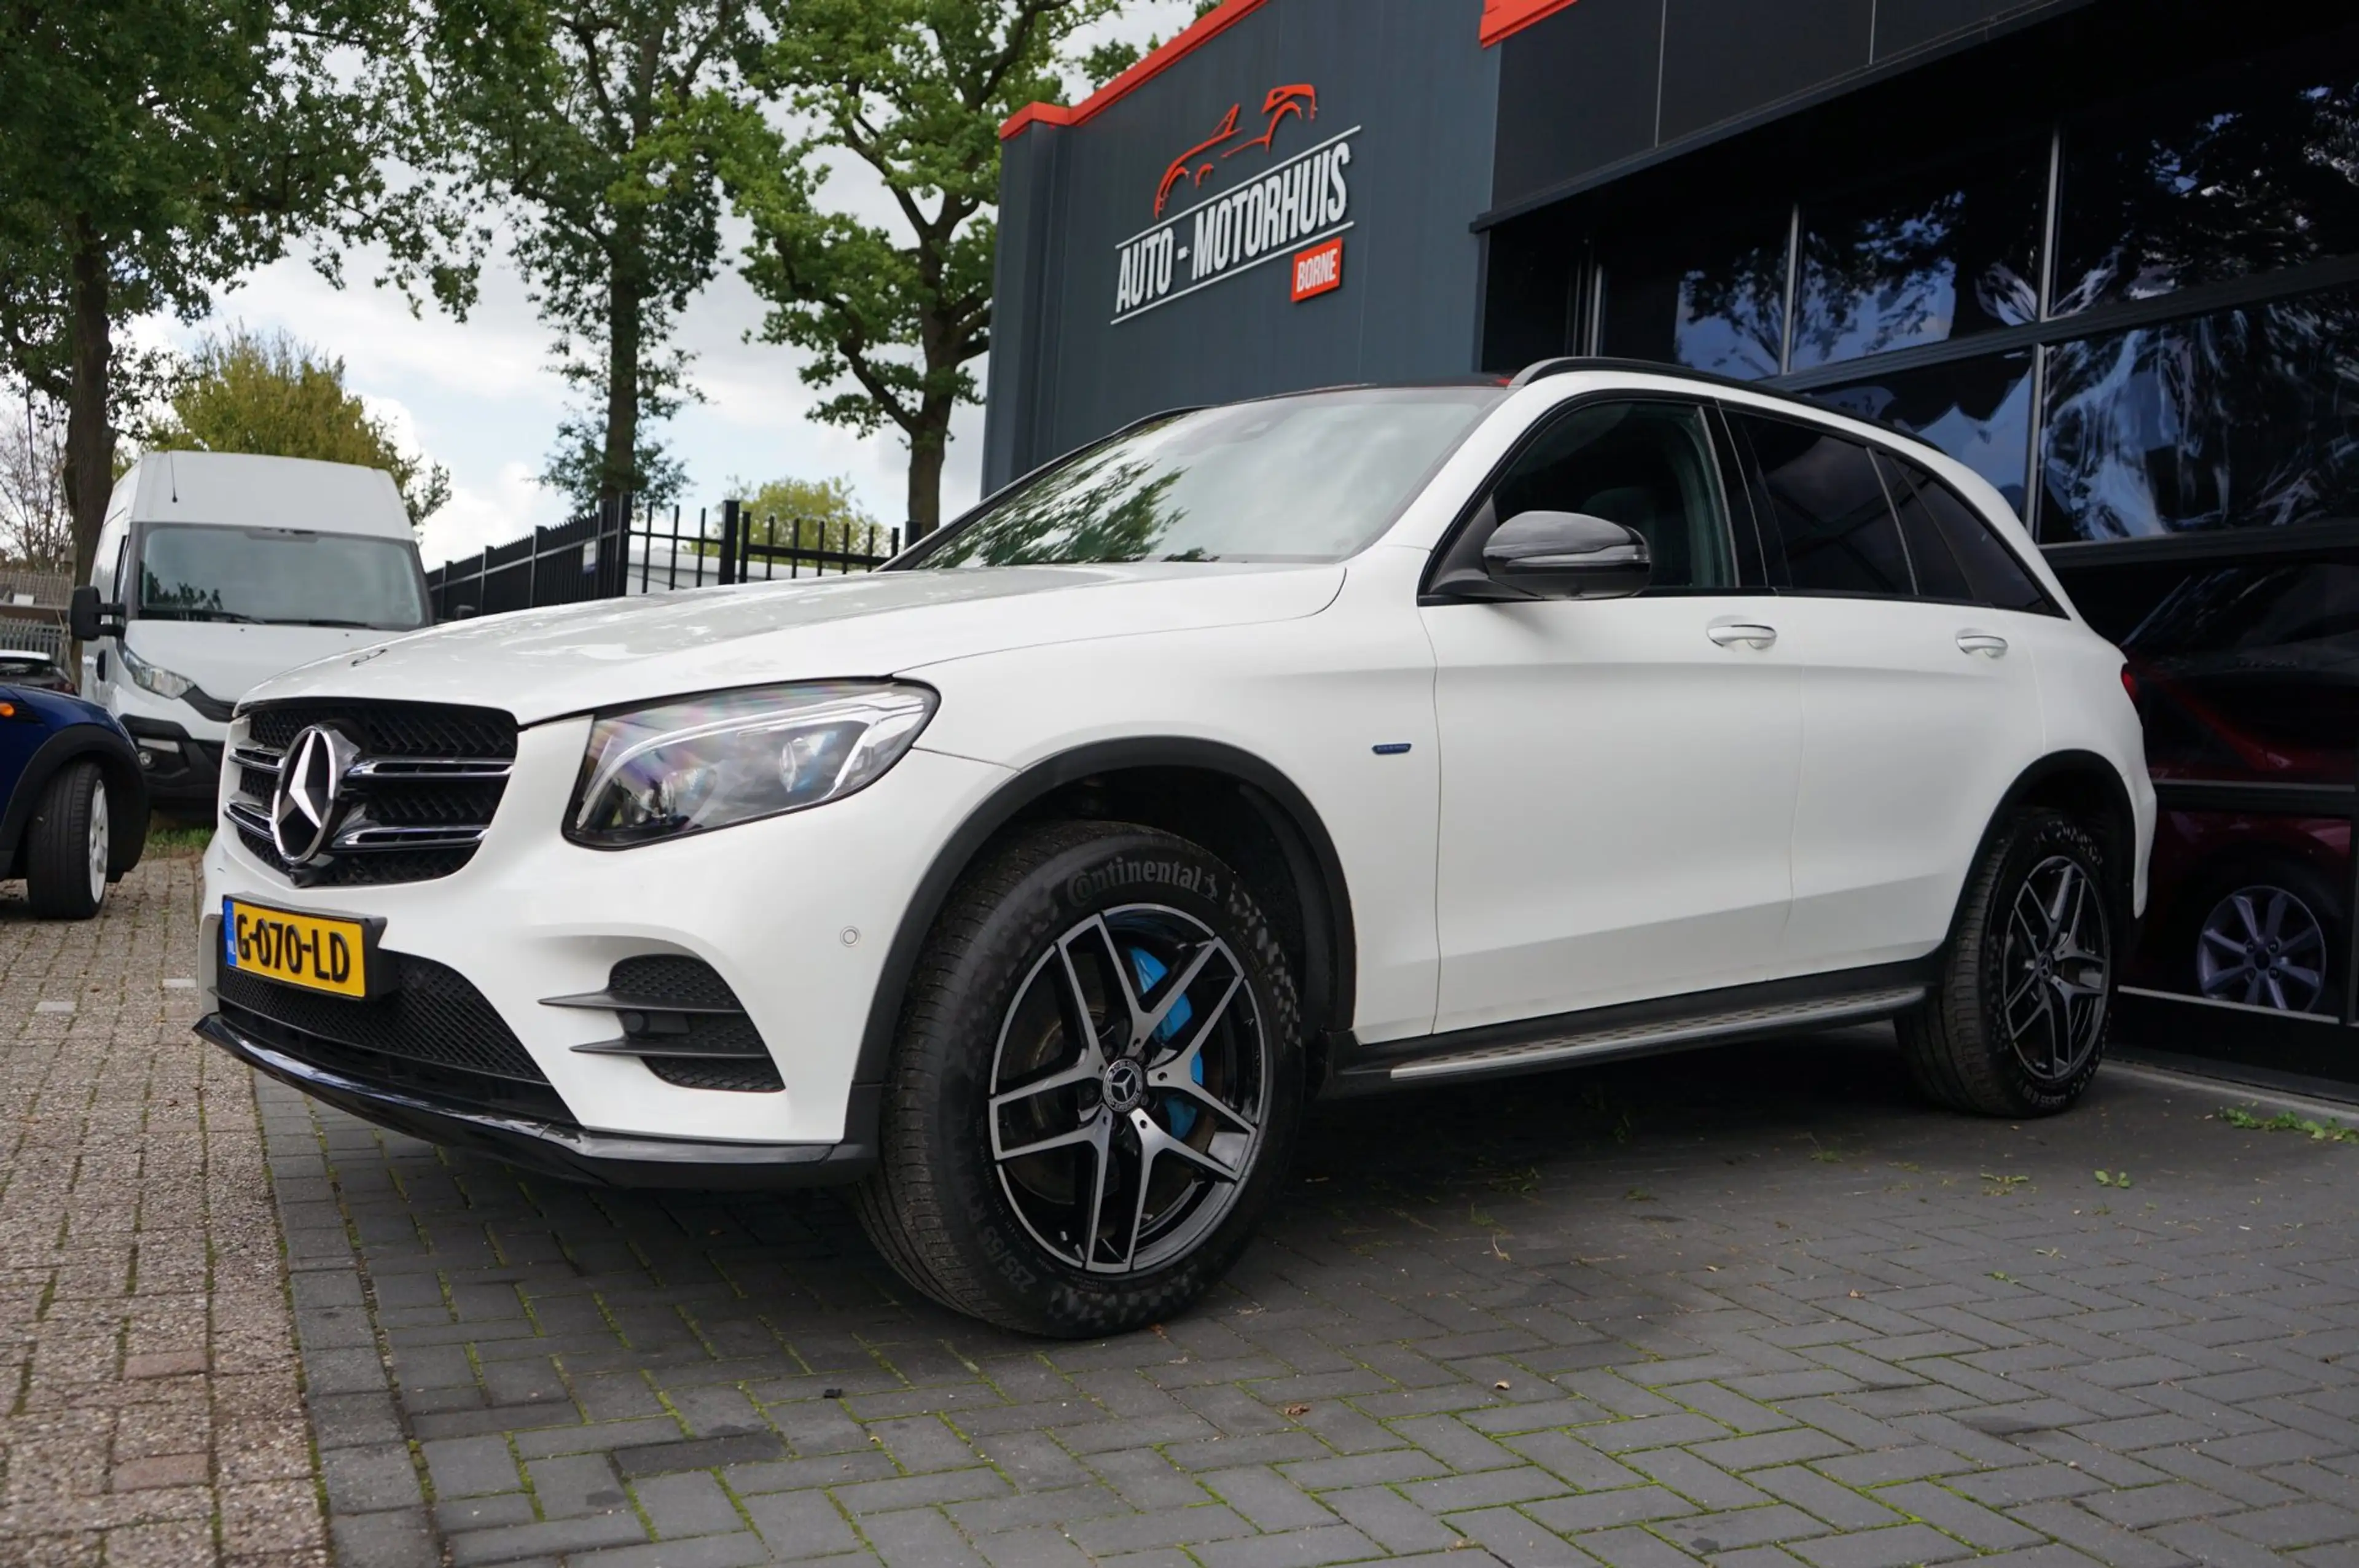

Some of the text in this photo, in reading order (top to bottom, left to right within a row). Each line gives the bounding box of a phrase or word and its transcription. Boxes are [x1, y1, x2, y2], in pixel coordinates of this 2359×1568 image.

[1116, 227, 1174, 313] AUTO
[1191, 142, 1350, 281] MOTORHUIS
[1296, 248, 1338, 293] BORNE
[1066, 856, 1202, 907] Continental
[236, 913, 350, 983] G-070-LD
